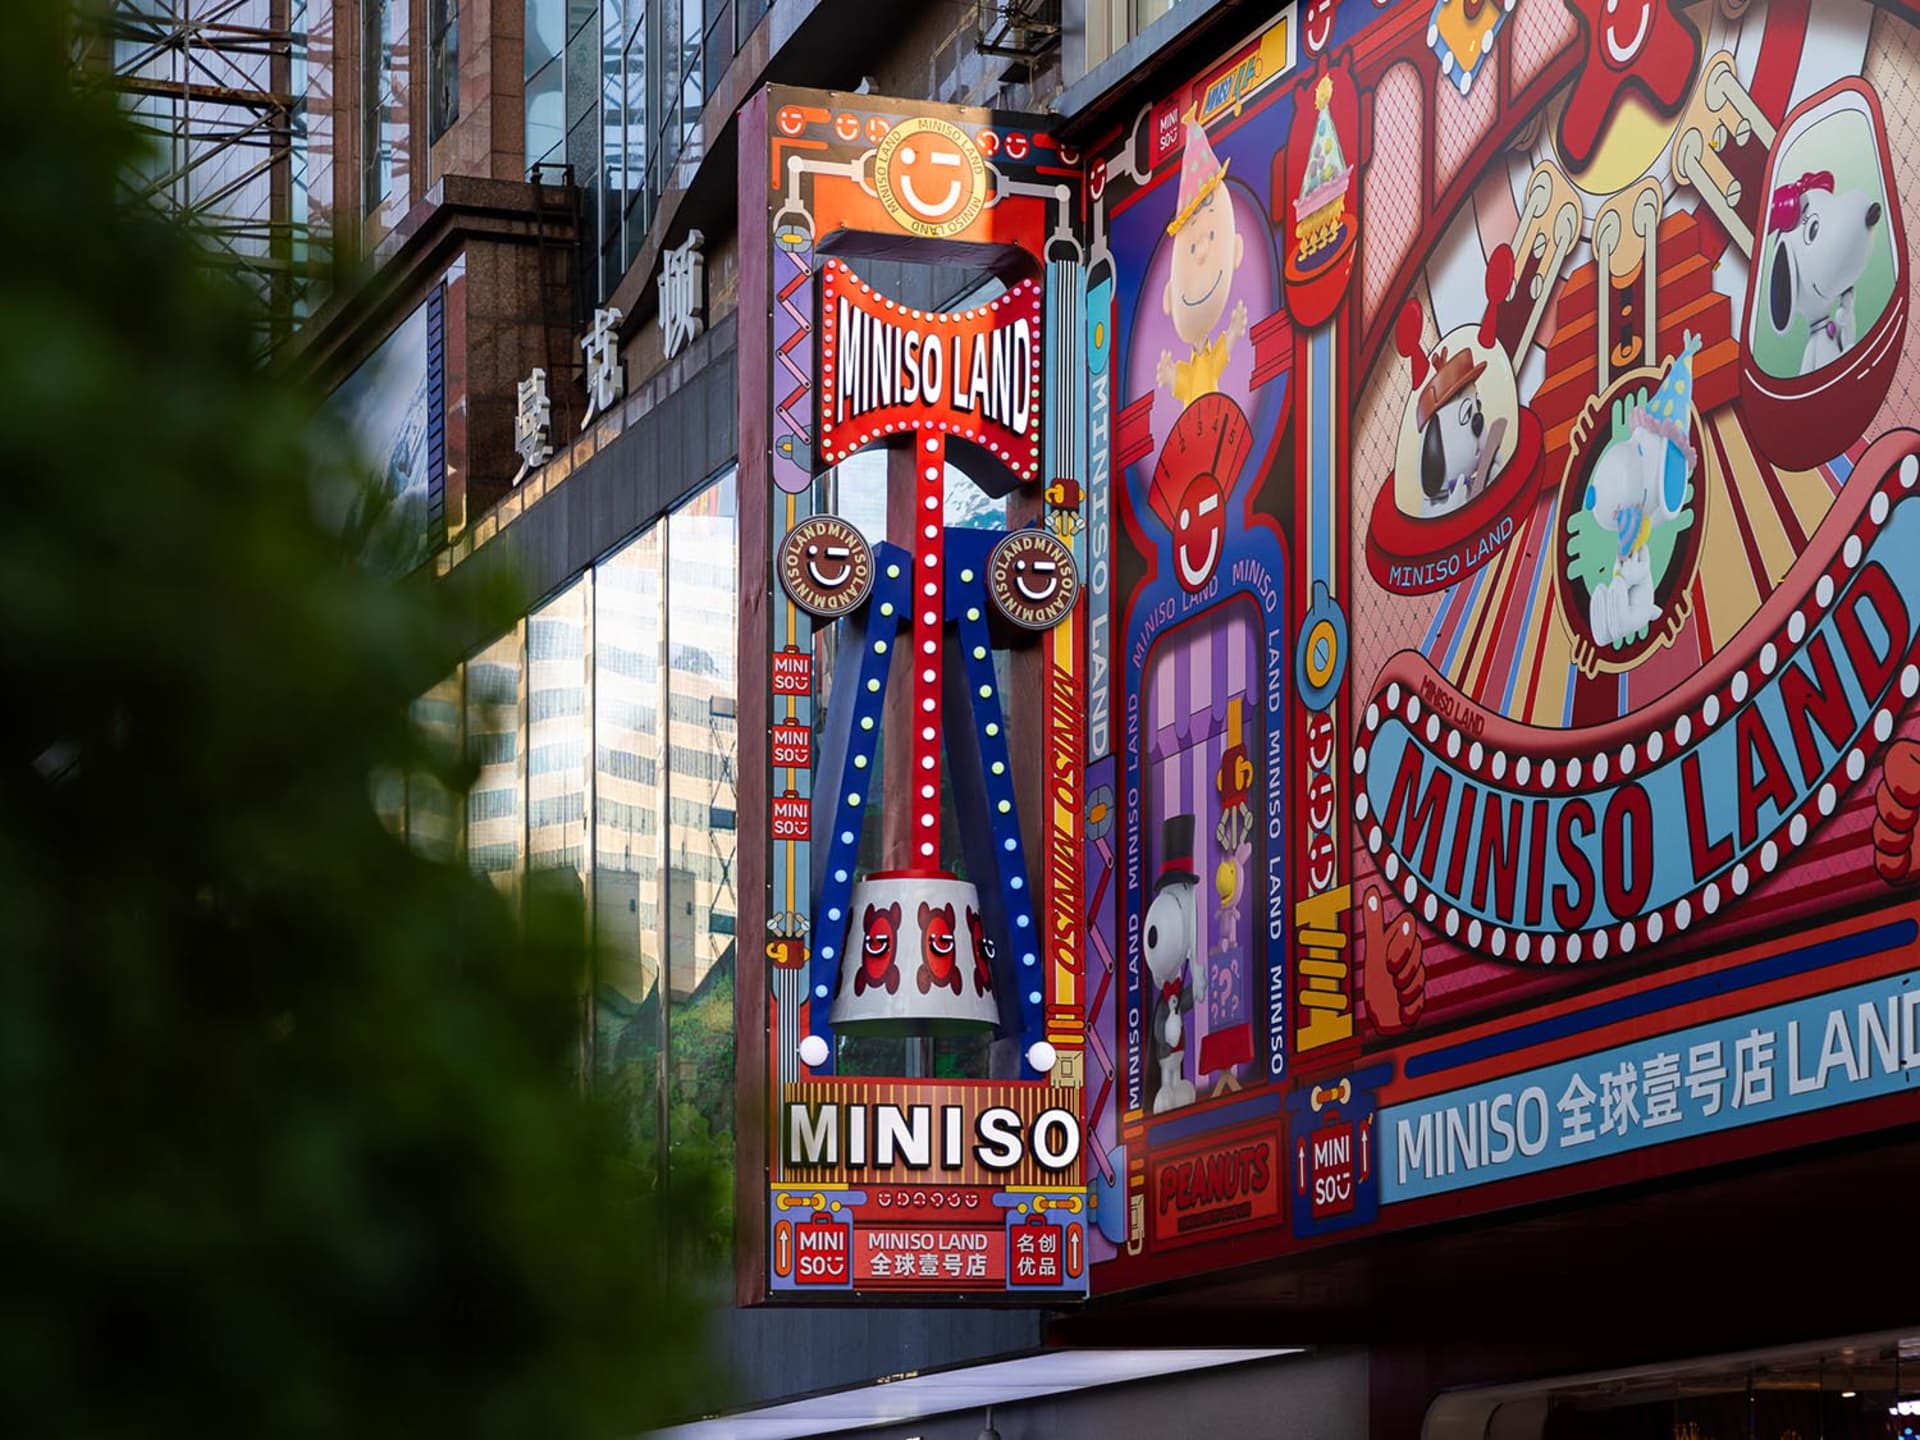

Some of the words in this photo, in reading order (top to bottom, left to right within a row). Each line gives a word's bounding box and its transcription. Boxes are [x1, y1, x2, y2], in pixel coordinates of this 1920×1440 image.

[879, 130, 902, 163] LAND
[918, 119, 961, 141] MINISO
[961, 140, 984, 175] LAND
[1160, 108, 1178, 133] MINI
[877, 167, 899, 214] MINISO
[947, 196, 982, 231] MINISO
[836, 295, 944, 425] MINISO
[953, 317, 1032, 436] LAND
[1091, 374, 1109, 595] MINISO
[1232, 559, 1278, 614] MINISO
[1389, 553, 1460, 588] MINISO
[1466, 516, 1514, 569] LAND
[774, 658, 809, 674] MINI
[1132, 597, 1176, 669] MINISO
[1091, 614, 1109, 757] LAND
[1267, 629, 1281, 713] LAND
[1419, 674, 1453, 719] MINISO
[1453, 706, 1486, 737] LAND
[774, 731, 809, 746] MINI
[1050, 662, 1083, 815] MINISO
[1128, 692, 1139, 772] LAND
[1383, 736, 1654, 933] MINISO
[1680, 559, 1910, 885] LAND
[774, 803, 808, 818] MINI
[1268, 729, 1282, 840] MINISO
[1128, 787, 1140, 890] MINISO
[1051, 824, 1084, 976] MINISO
[1269, 856, 1282, 940] LAND
[1128, 913, 1140, 992] LAND
[1270, 964, 1285, 1075] MINISO
[1128, 1007, 1140, 1110] MINISO
[788, 1103, 1081, 1171] MINISO
[1396, 1086, 1550, 1186] MINISO
[1556, 1027, 1776, 1149] 全球壹号店
[1158, 1142, 1271, 1217] PEANUTS
[1313, 1134, 1351, 1172] MINI
[800, 1230, 845, 1252] MINI
[868, 1232, 935, 1251] MINISO
[938, 1232, 988, 1251] LAND
[869, 1252, 989, 1278] 全球壹号店
[1016, 1233, 1057, 1254] 名创
[1016, 1257, 1057, 1278] 优品
